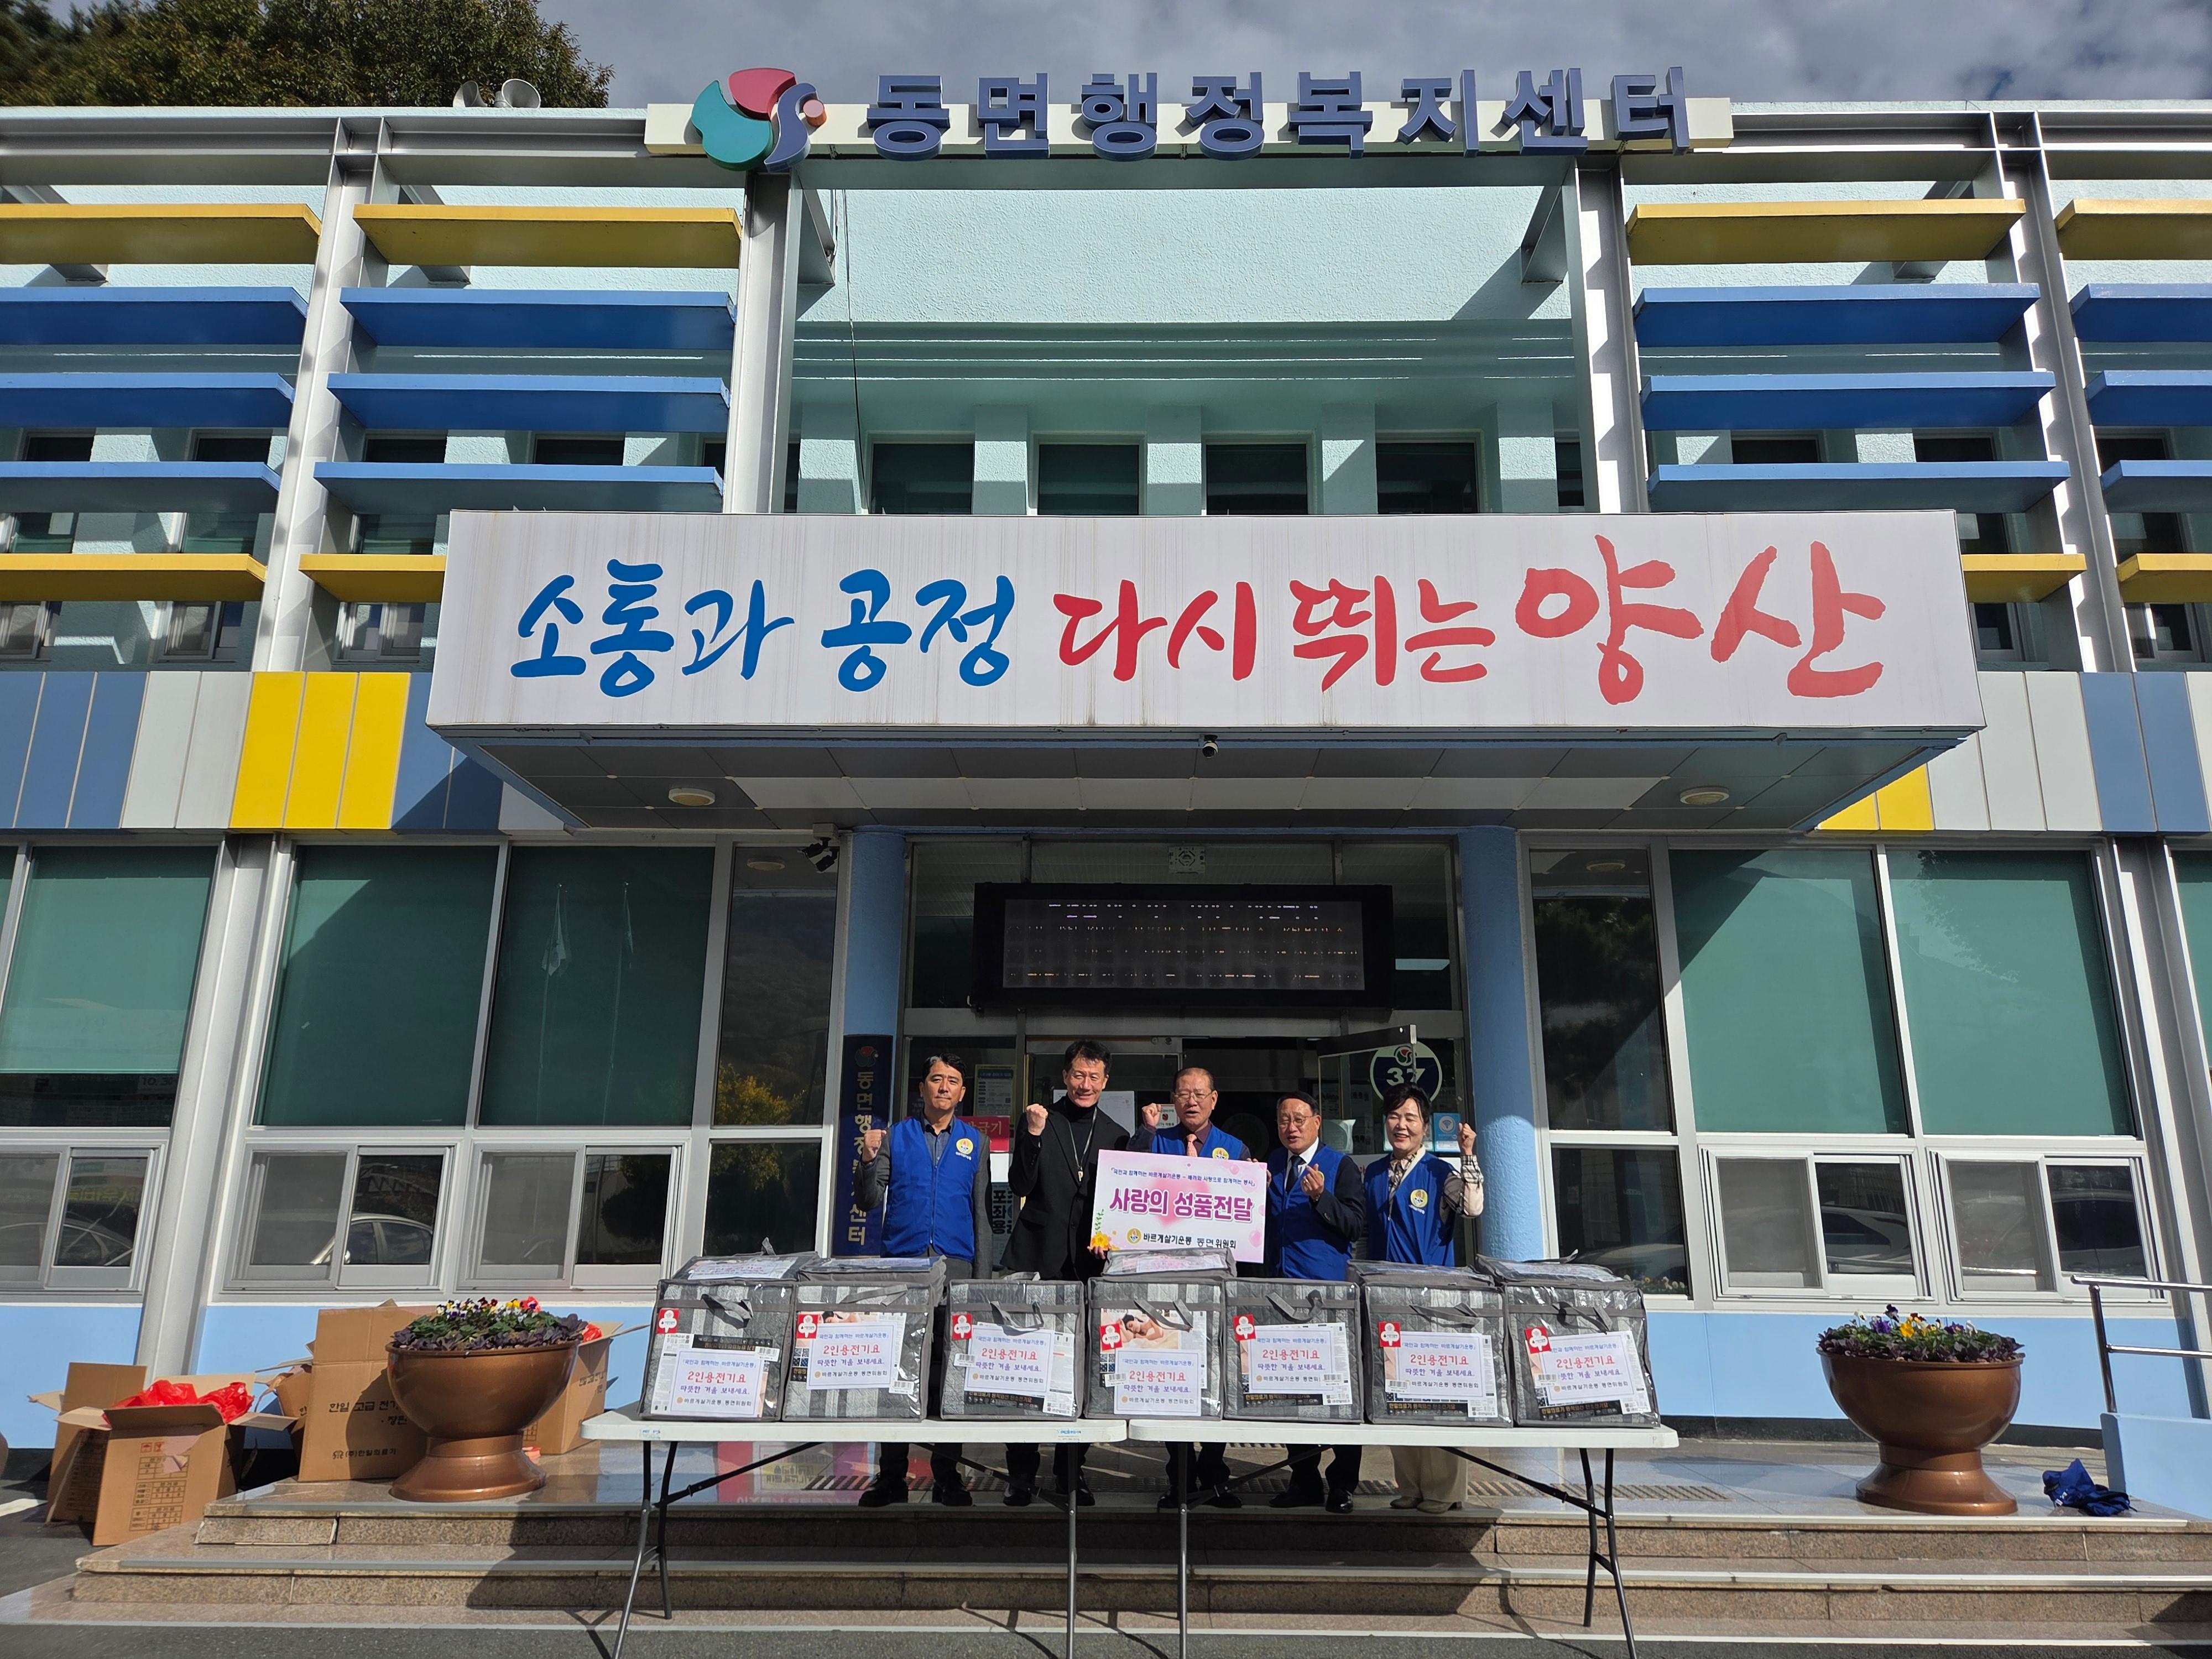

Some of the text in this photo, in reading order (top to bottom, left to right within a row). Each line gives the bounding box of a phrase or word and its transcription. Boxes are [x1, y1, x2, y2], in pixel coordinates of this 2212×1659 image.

[867, 67, 1690, 161] 동면행정복지센터
[510, 536, 1882, 705] 소통과 공정 다시 뛰는 양산
[1386, 1067, 1426, 1086] 37
[1109, 1187, 1253, 1222] 사랑의 성품전달
[1143, 1233, 1192, 1246] 바르게살기운동
[823, 1344, 880, 1356] 2인용전기요
[982, 1348, 1037, 1360] 2인용전기요
[1262, 1349, 1320, 1361] 2인용전기요
[1411, 1354, 1469, 1366] 2인용전기요
[1556, 1355, 1615, 1369] 2인용전기요
[687, 1371, 746, 1384] 2인용전기요
[1129, 1370, 1186, 1383] 2인용전기요
[1558, 1372, 1574, 1381] 뜻한
[328, 1400, 399, 1413] 한일 고급 전기
